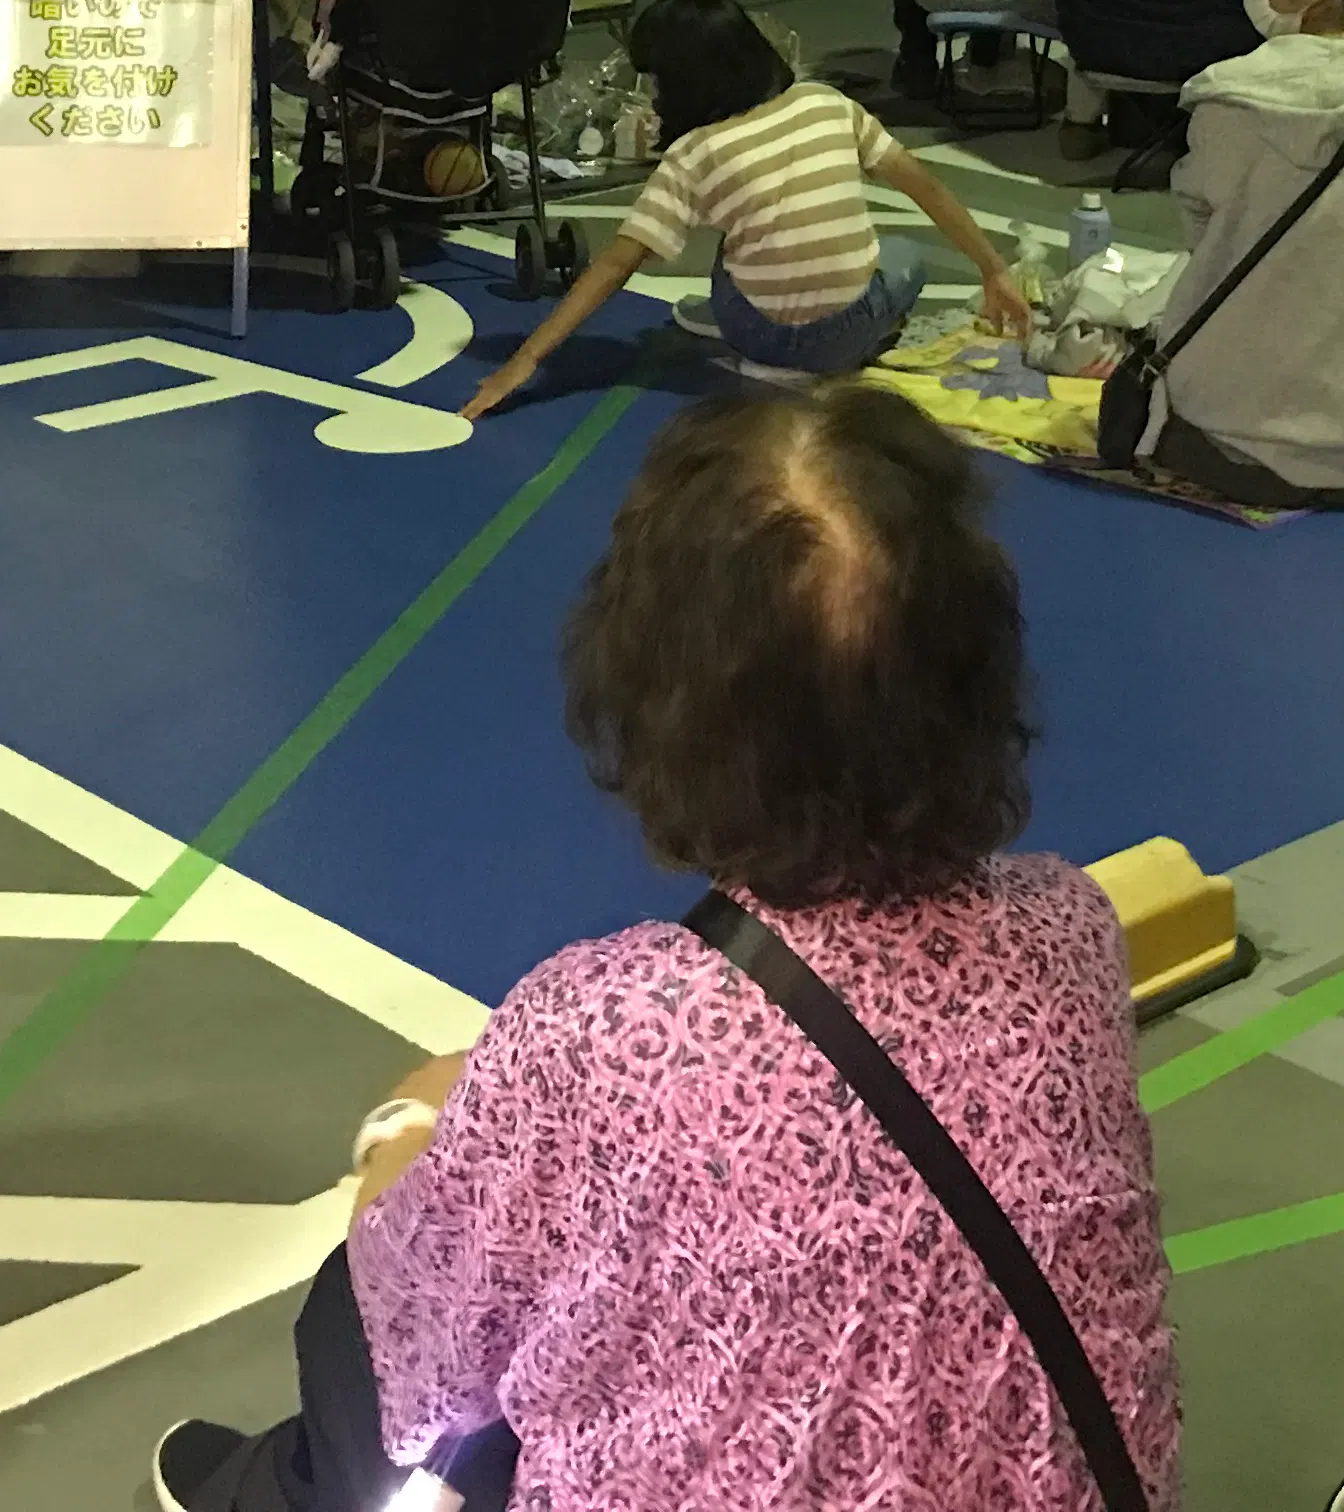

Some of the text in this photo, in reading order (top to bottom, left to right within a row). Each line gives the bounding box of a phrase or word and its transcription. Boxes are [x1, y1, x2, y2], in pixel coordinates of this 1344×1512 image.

[44, 25, 146, 60] 足元に
[11, 63, 178, 99] お気を付け
[28, 102, 162, 138] ください
